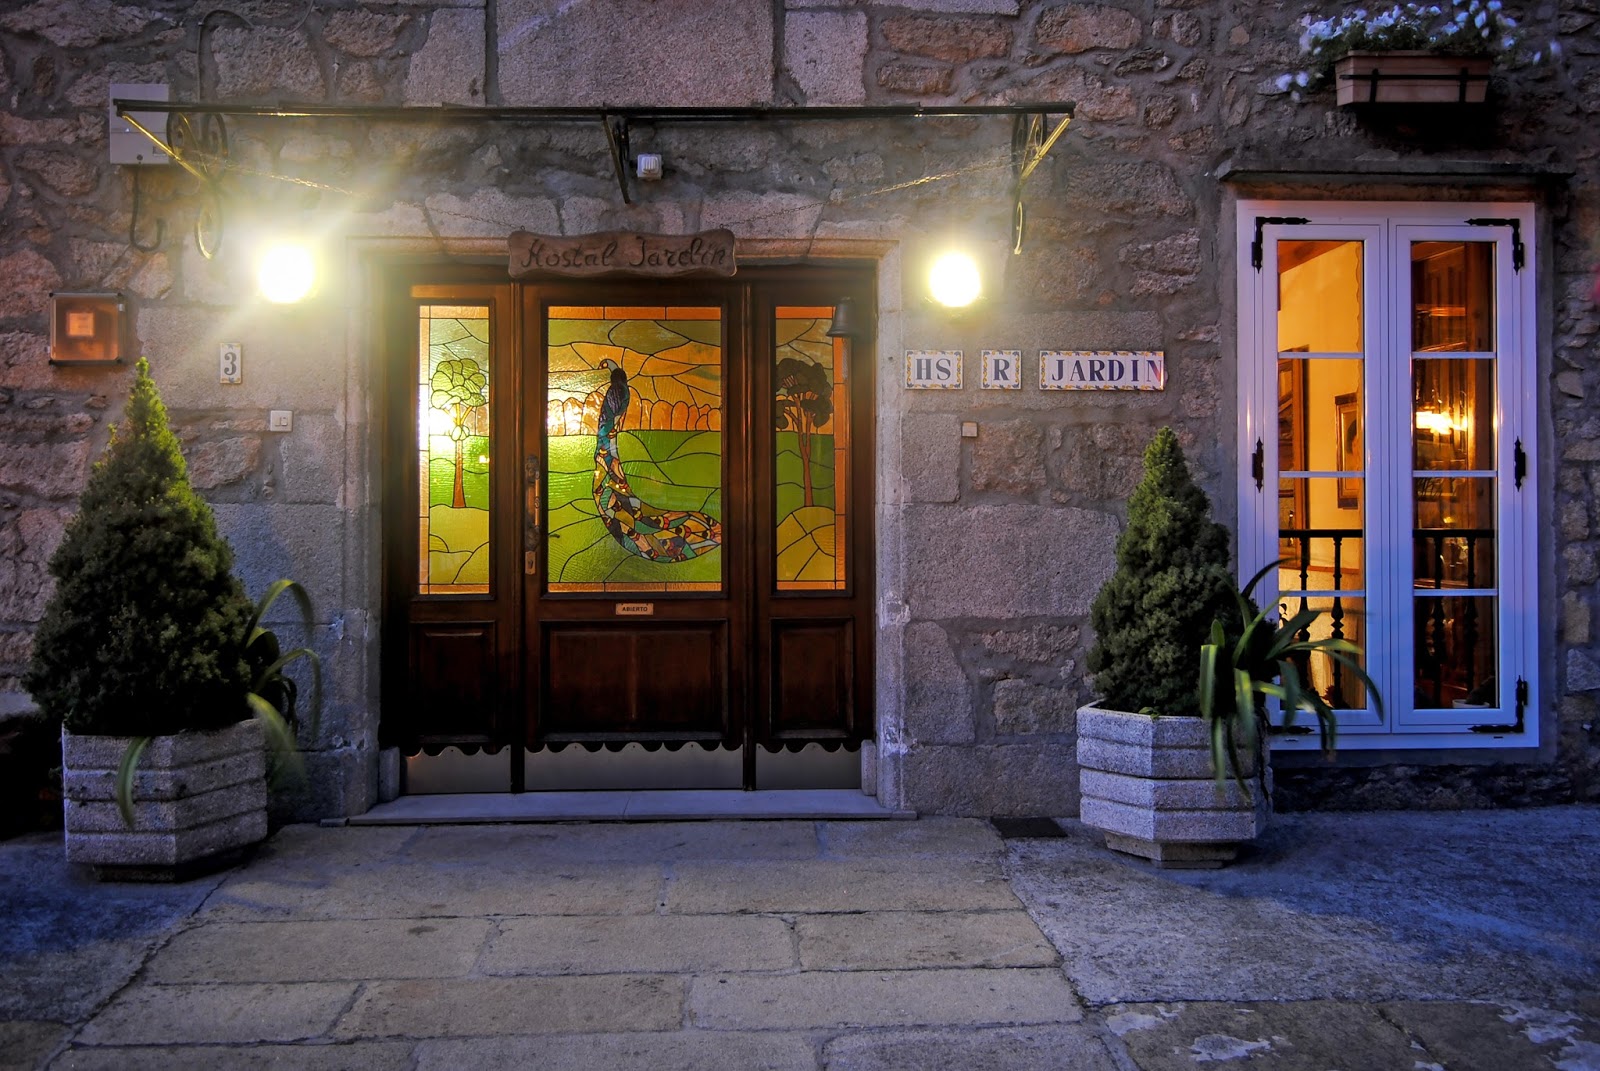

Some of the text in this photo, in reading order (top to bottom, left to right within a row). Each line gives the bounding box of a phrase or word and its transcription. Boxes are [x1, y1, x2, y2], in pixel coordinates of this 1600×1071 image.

[520, 238, 618, 268] Hostal
[224, 352, 237, 376] 3
[915, 358, 1162, 382] HS R JARDIN
